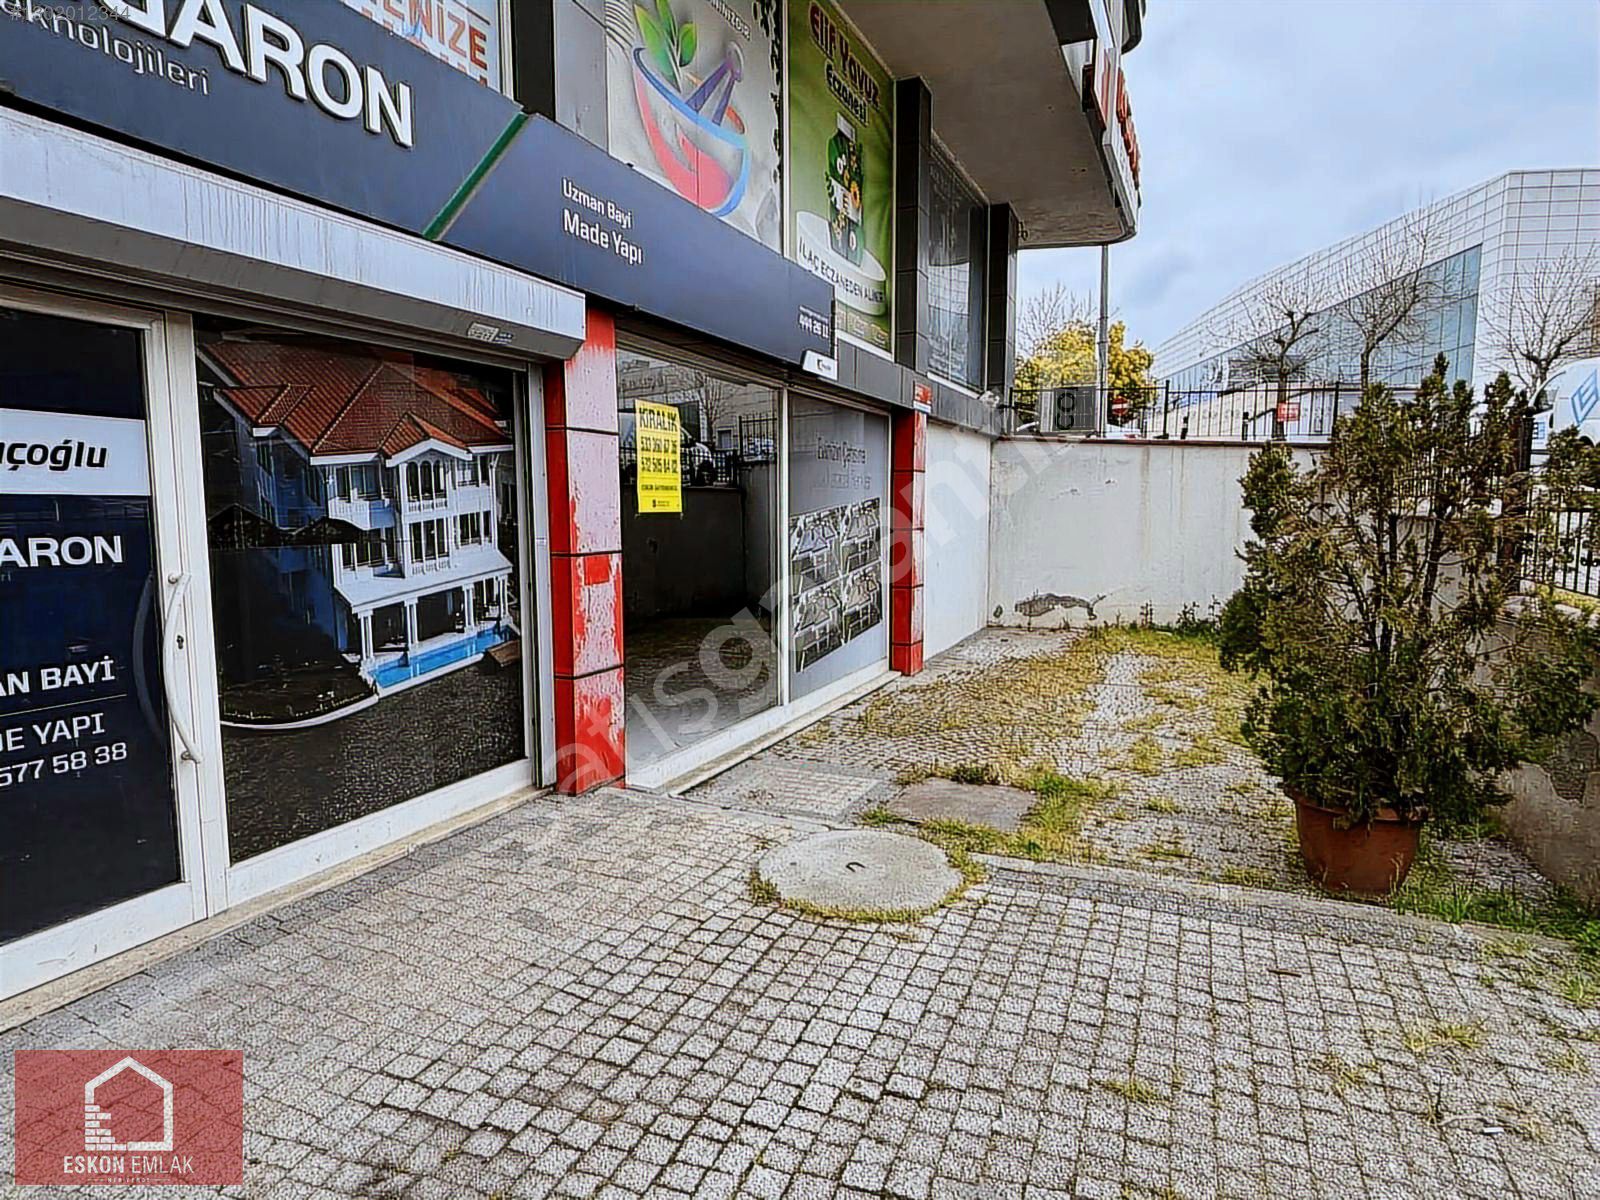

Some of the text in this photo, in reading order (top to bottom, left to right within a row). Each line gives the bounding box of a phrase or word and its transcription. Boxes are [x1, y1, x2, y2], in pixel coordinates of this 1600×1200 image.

[562, 178, 632, 229] Uzman Bayi
[563, 208, 643, 265] Made Yapı
[40, 656, 115, 691] BAYİ
[32, 712, 106, 745] YAPI
[52, 751, 87, 774] 58
[94, 742, 128, 766] 38
